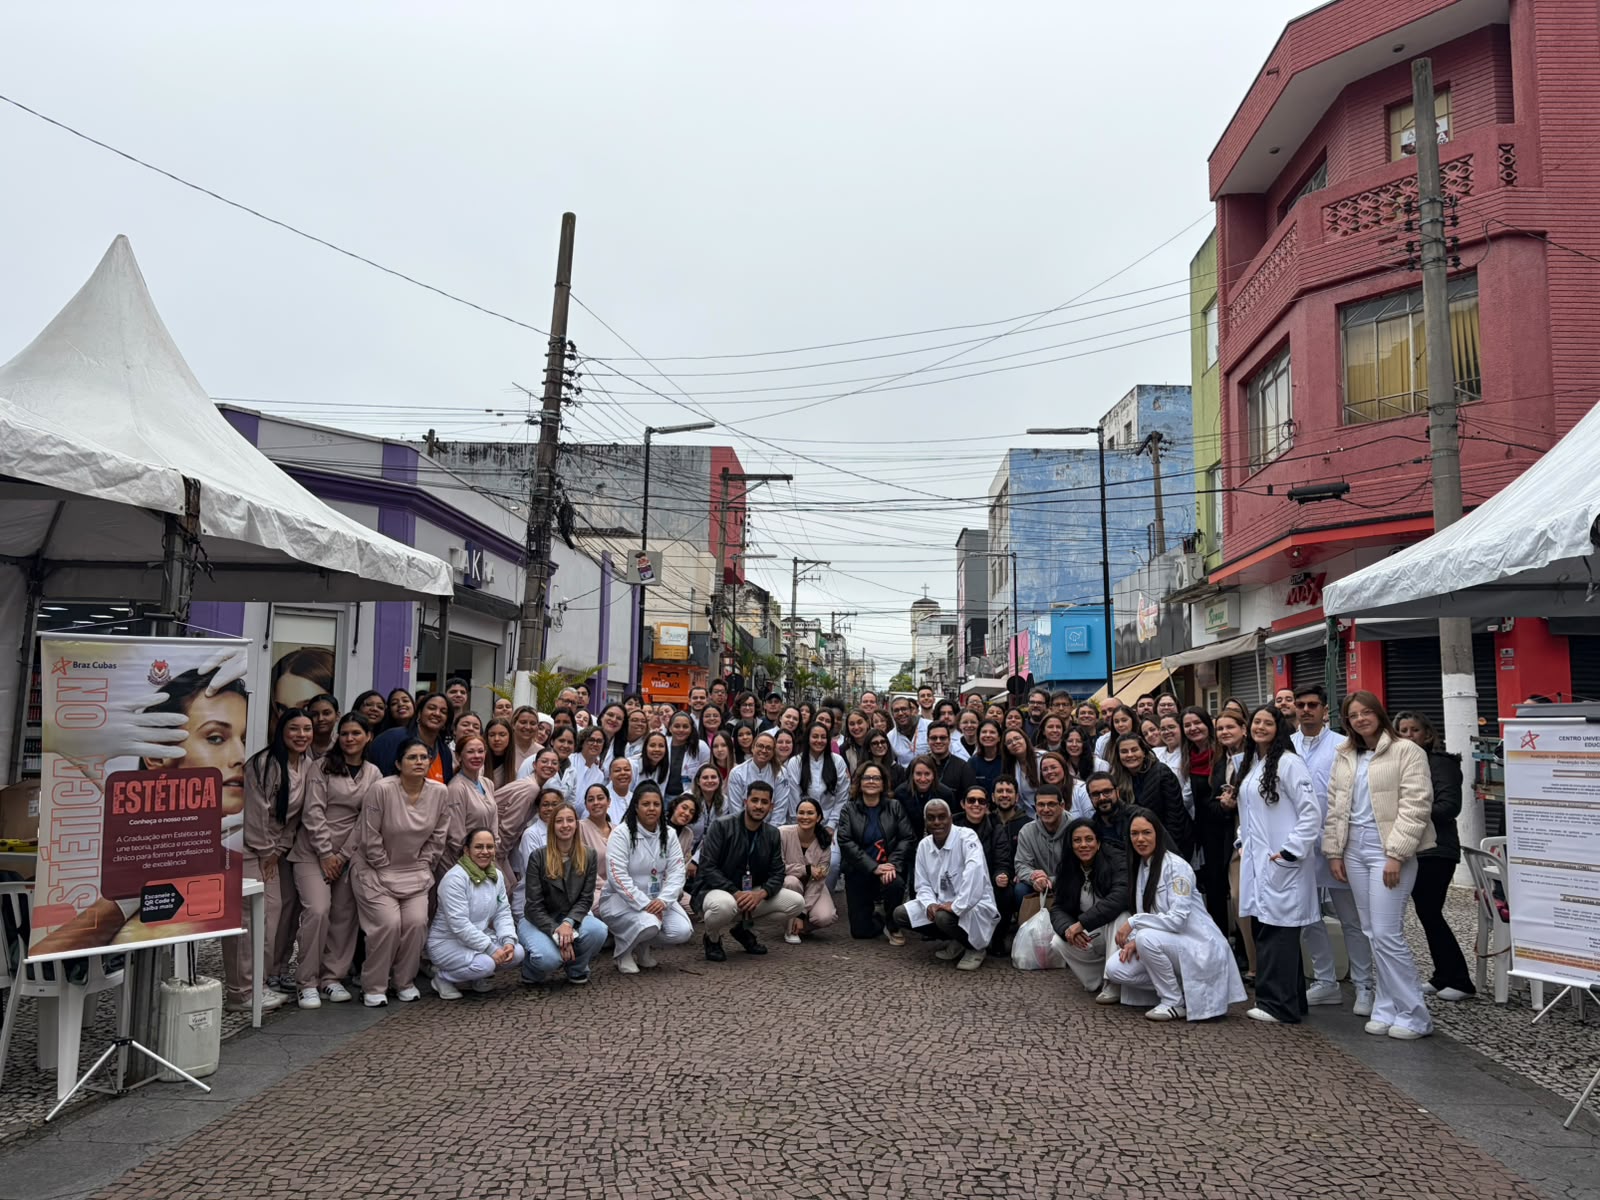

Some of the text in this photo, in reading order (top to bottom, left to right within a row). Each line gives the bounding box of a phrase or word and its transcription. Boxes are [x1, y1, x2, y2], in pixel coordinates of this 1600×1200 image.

[1285, 572, 1327, 606] MAX
[72, 661, 117, 669] Braz Cubas
[55, 677, 109, 730] ON
[112, 773, 217, 814] ESTÉTICA
[129, 818, 157, 826] Conheça
[123, 833, 160, 843] Graduação
[174, 831, 198, 839] Estética
[199, 829, 212, 838] que
[116, 845, 131, 853] une
[153, 841, 176, 850] prática
[136, 853, 152, 861] para
[152, 850, 176, 859] formar
[175, 847, 214, 857] profissionais
[152, 859, 187, 868] excelência
[143, 904, 159, 912] saiba
